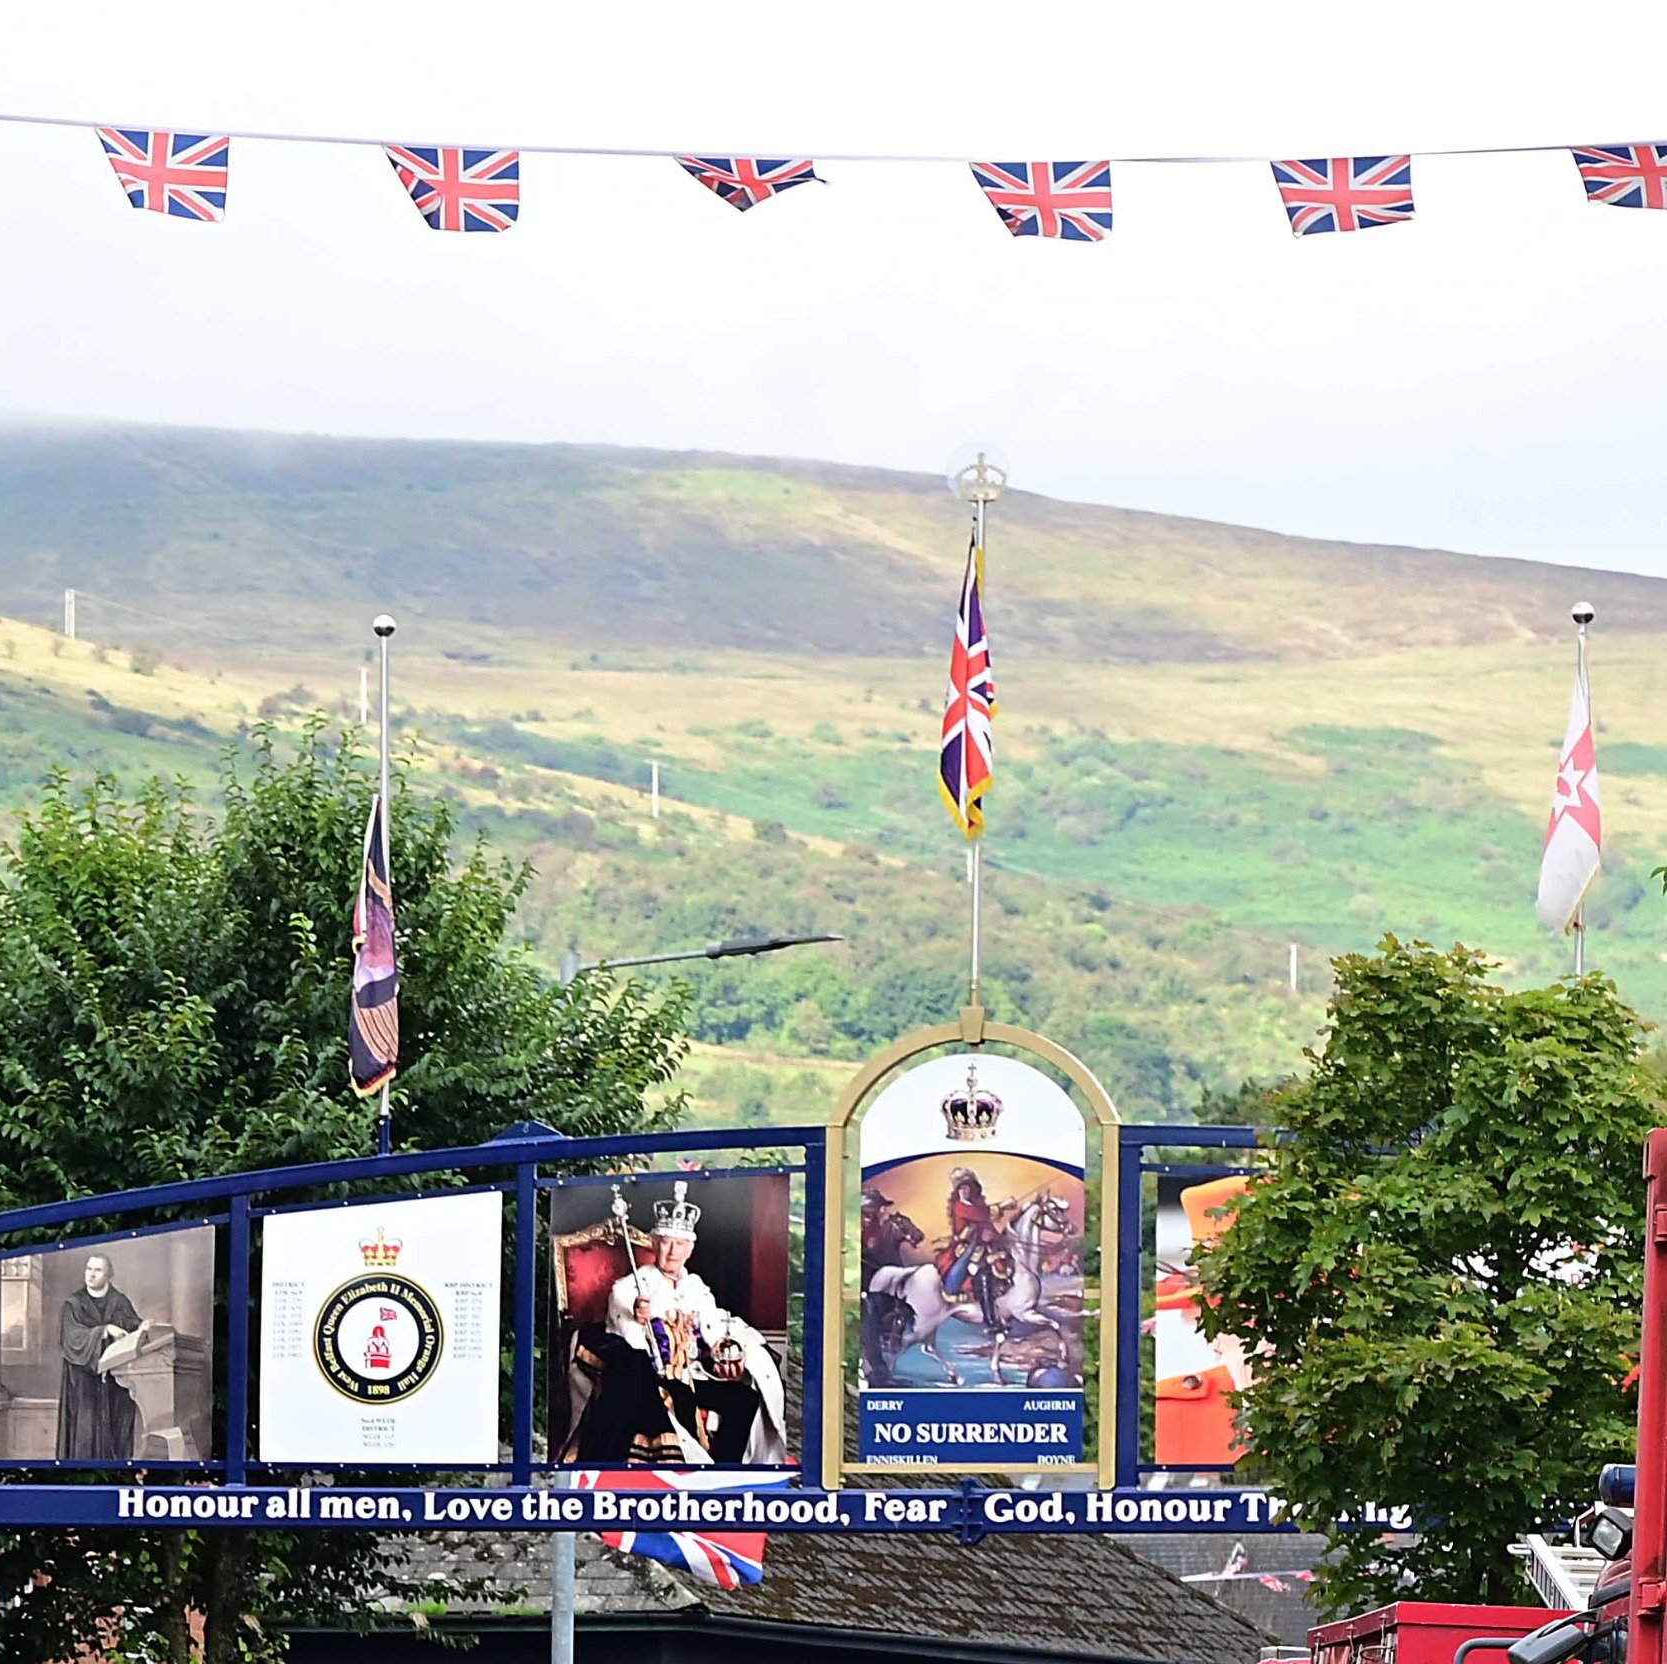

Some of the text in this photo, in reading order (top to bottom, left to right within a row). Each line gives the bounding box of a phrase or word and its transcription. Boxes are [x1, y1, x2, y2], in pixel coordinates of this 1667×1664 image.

[341, 1282, 388, 1305] Elizabeth
[322, 1304, 344, 1335] Queen
[400, 1287, 436, 1334] Memorial
[323, 1337, 341, 1372] Belfast
[415, 1335, 436, 1372] Orange
[337, 1370, 359, 1393] West
[368, 1385, 391, 1395] 1898
[397, 1371, 420, 1392] Hall
[867, 1400, 1076, 1411] DERRY AUGHRIM
[874, 1422, 1069, 1443] NO SURRENDER
[866, 1455, 1076, 1465] ENNISKILLEN BOYNE
[118, 1489, 260, 1520] Honour
[266, 1488, 312, 1519] all
[319, 1496, 413, 1522] men,
[424, 1492, 513, 1521] Love
[522, 1493, 584, 1521] the
[593, 1492, 851, 1525] Brotherhood,
[865, 1492, 947, 1523] Fear
[984, 1492, 1075, 1526] God,
[1087, 1492, 1231, 1524] Honour
